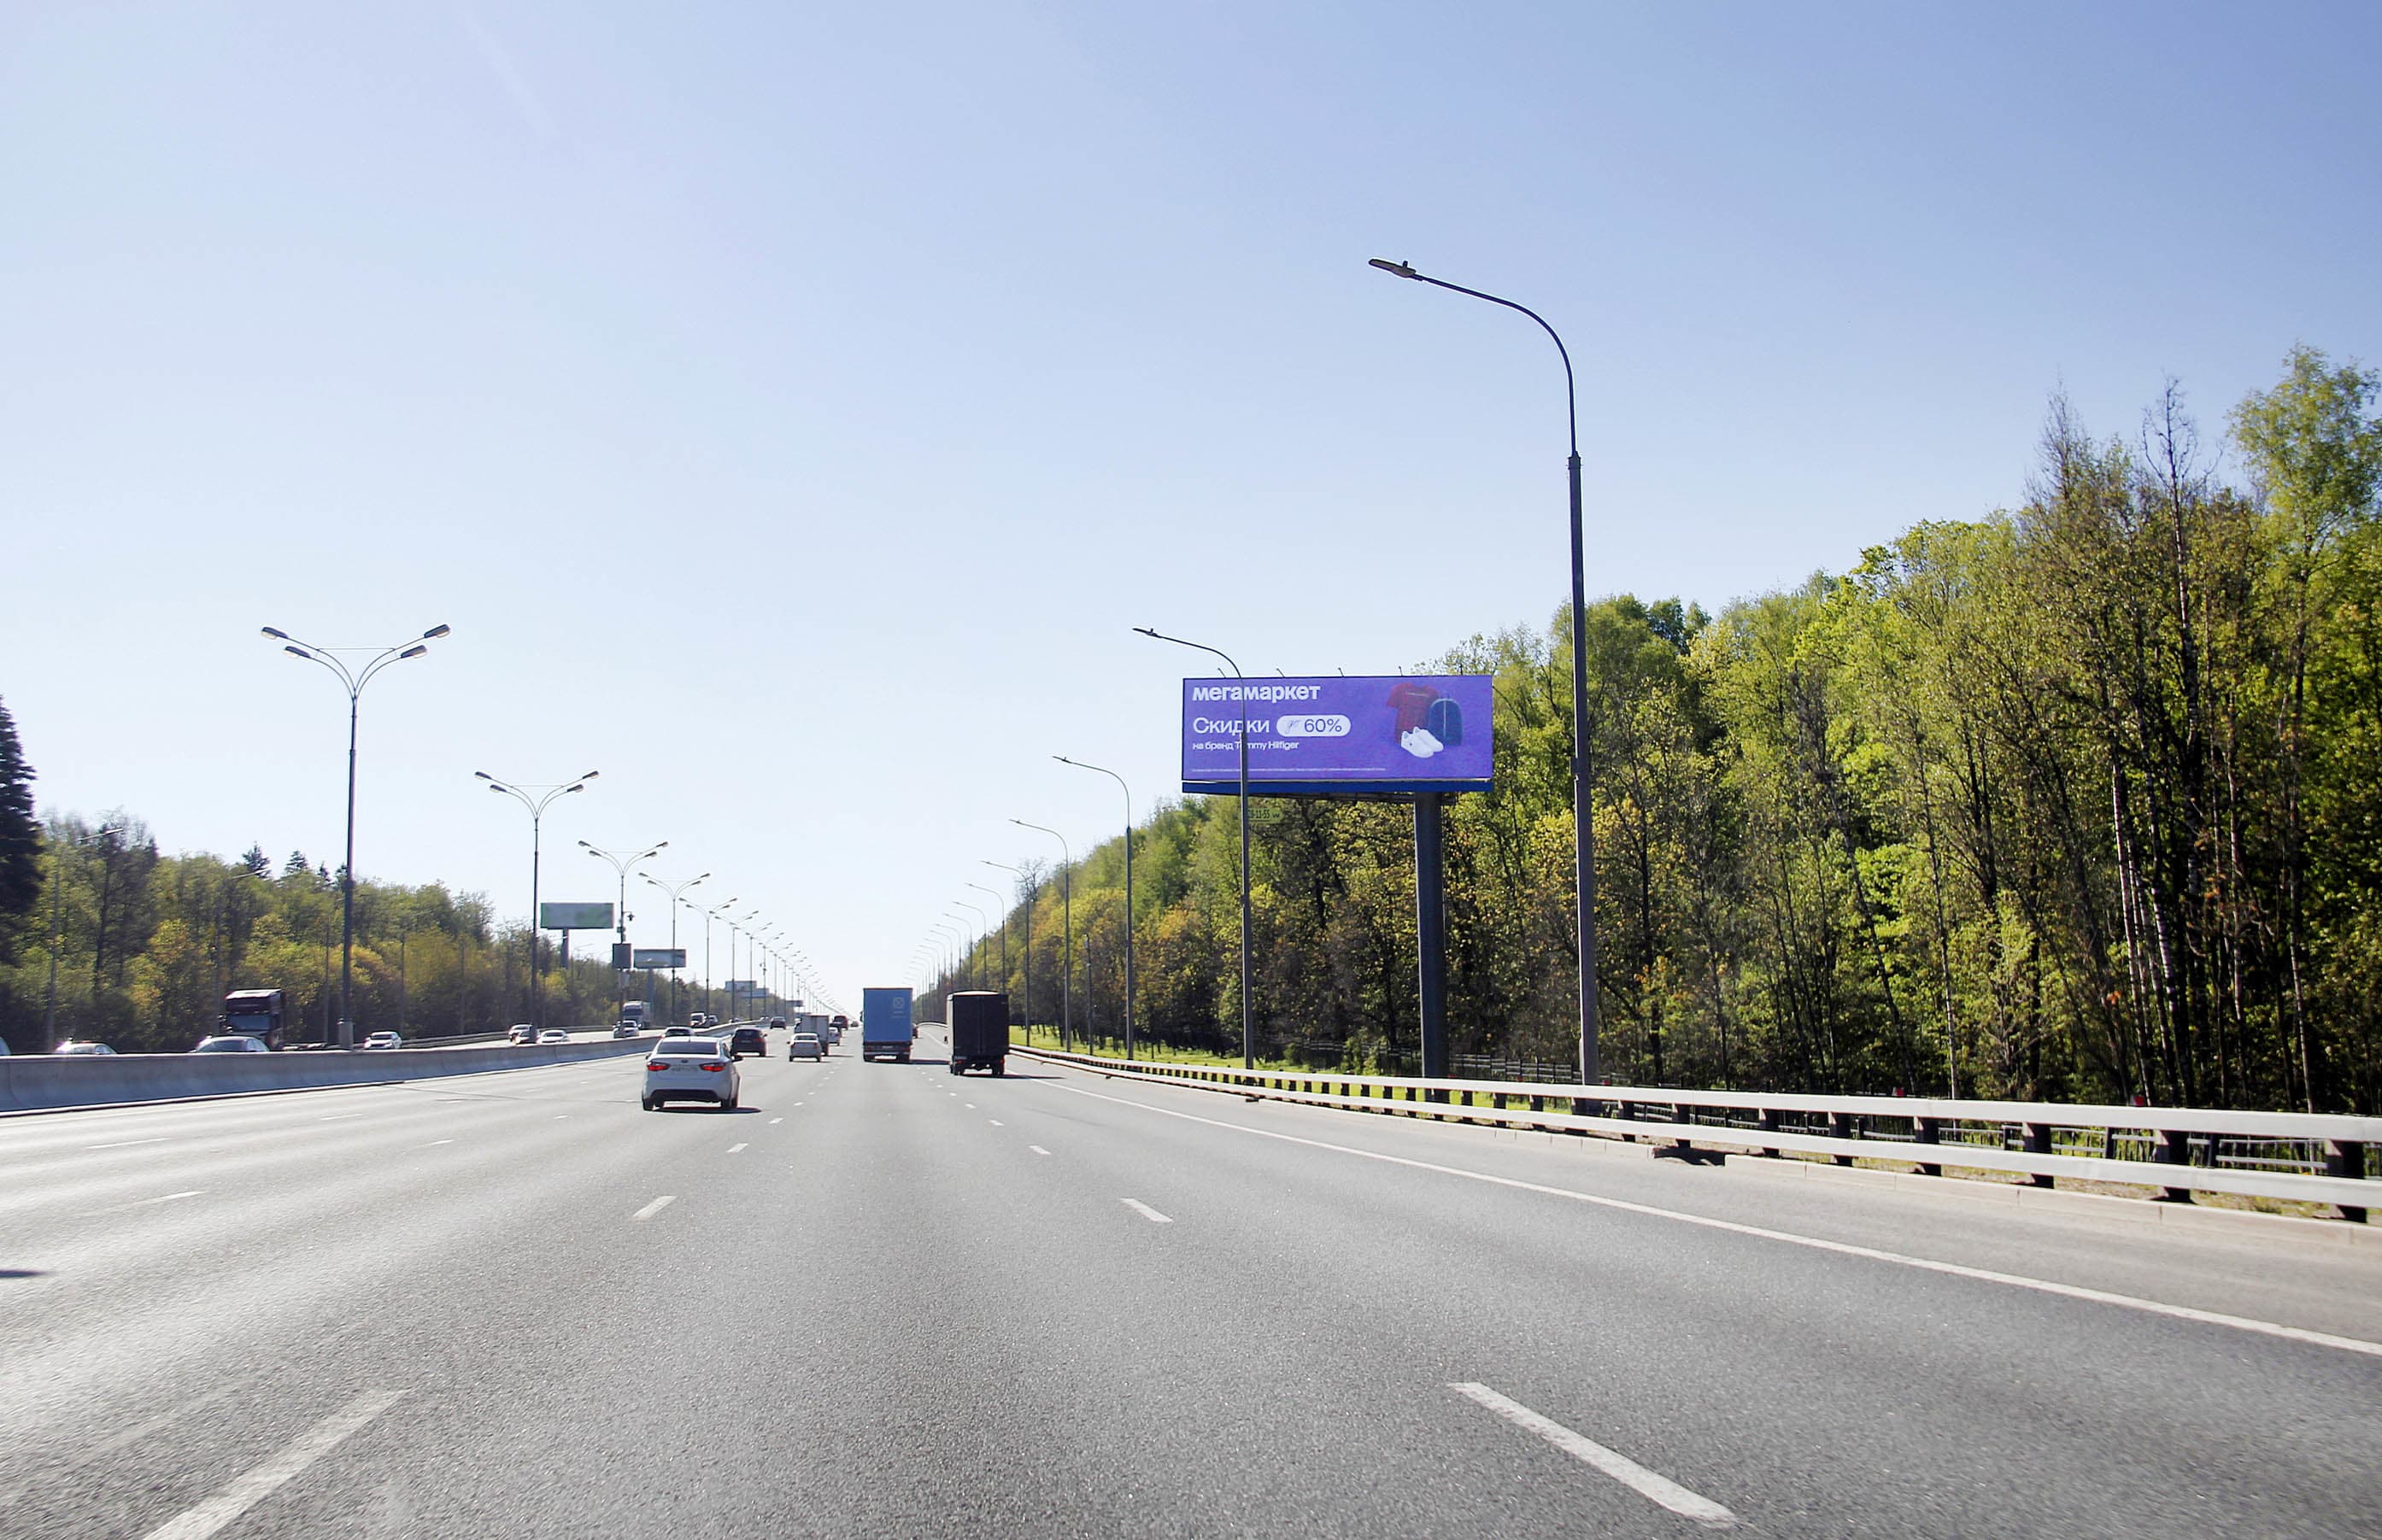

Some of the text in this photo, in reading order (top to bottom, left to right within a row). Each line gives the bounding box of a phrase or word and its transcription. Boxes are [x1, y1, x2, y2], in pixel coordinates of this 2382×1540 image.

[1192, 685, 1321, 703] мегамаркет
[1193, 717, 1270, 735] Скидки
[1304, 718, 1342, 733] 60%
[1205, 741, 1234, 751] бренд
[1235, 741, 1268, 751] Tmmy
[1268, 741, 1300, 751] Hilfiger
